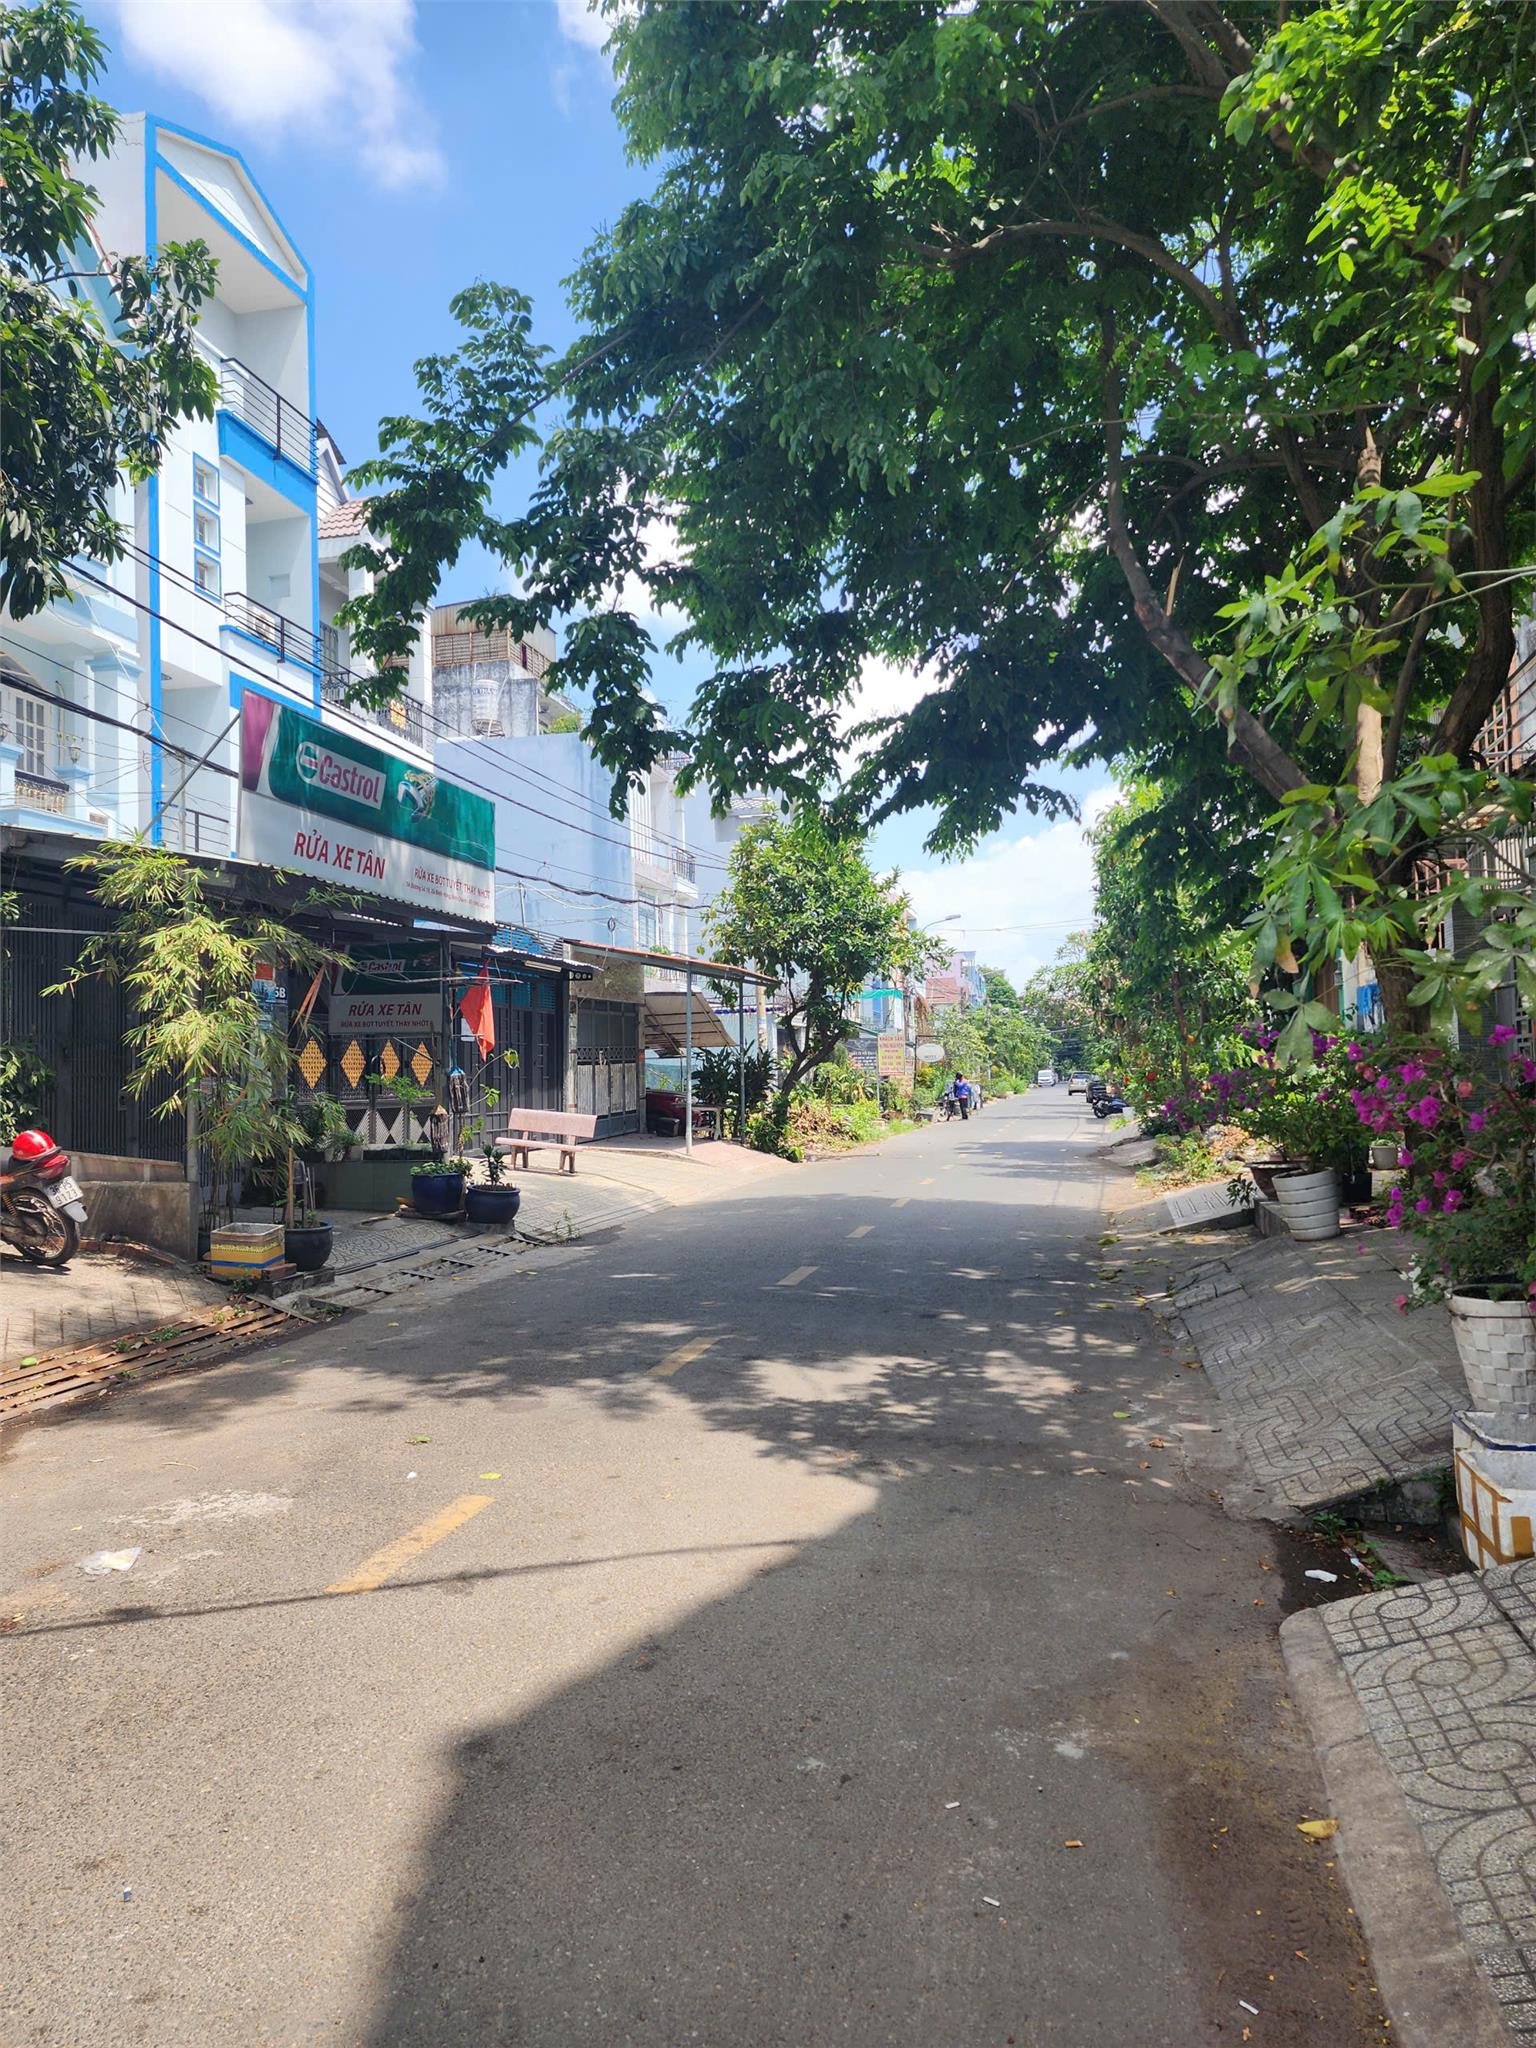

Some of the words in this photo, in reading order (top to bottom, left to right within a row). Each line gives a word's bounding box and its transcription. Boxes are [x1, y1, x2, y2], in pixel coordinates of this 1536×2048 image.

[319, 754, 380, 804] Castrol
[293, 828, 329, 865] RỬA
[332, 843, 355, 871] XE
[356, 848, 386, 880] TÂN
[348, 1000, 375, 1017] RỬA
[377, 1003, 394, 1016] XE
[396, 1001, 422, 1016] TÂN
[55, 1188, 78, 1205] 9123
